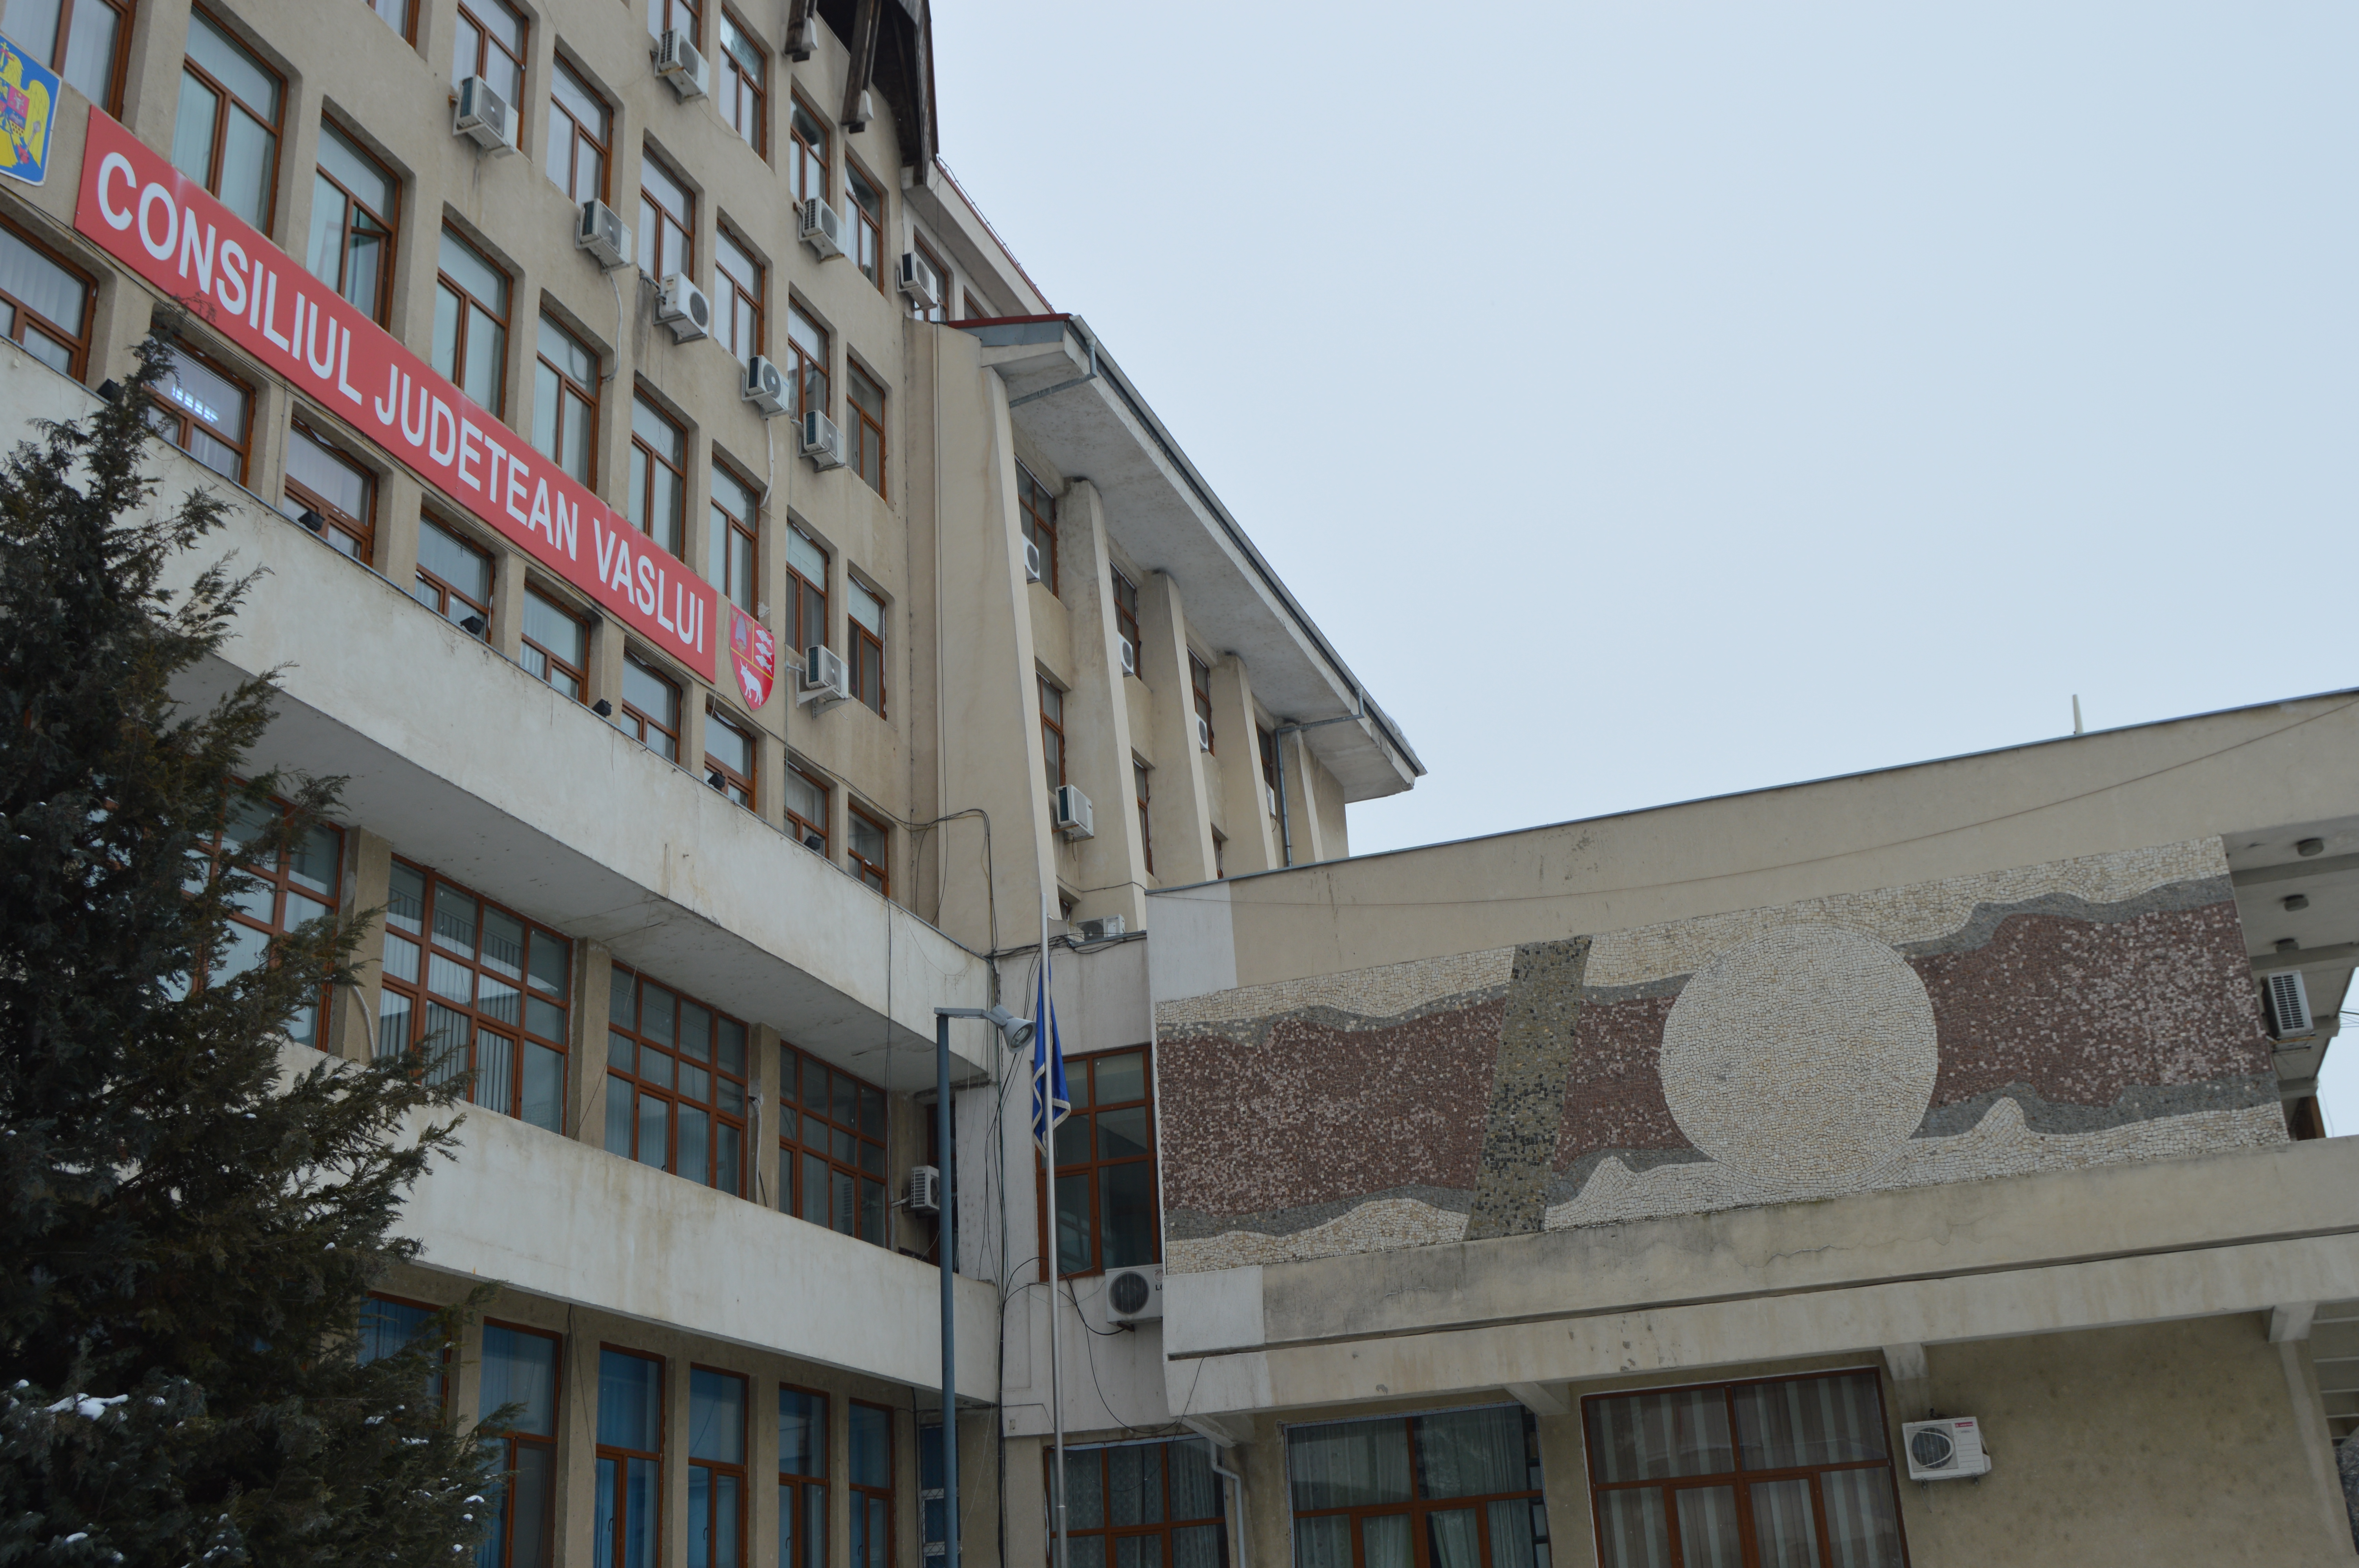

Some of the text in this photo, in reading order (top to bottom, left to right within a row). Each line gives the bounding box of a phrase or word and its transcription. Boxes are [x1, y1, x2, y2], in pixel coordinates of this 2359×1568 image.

[98, 152, 704, 654] CONSILIUL JUDETEAN VASLUI
